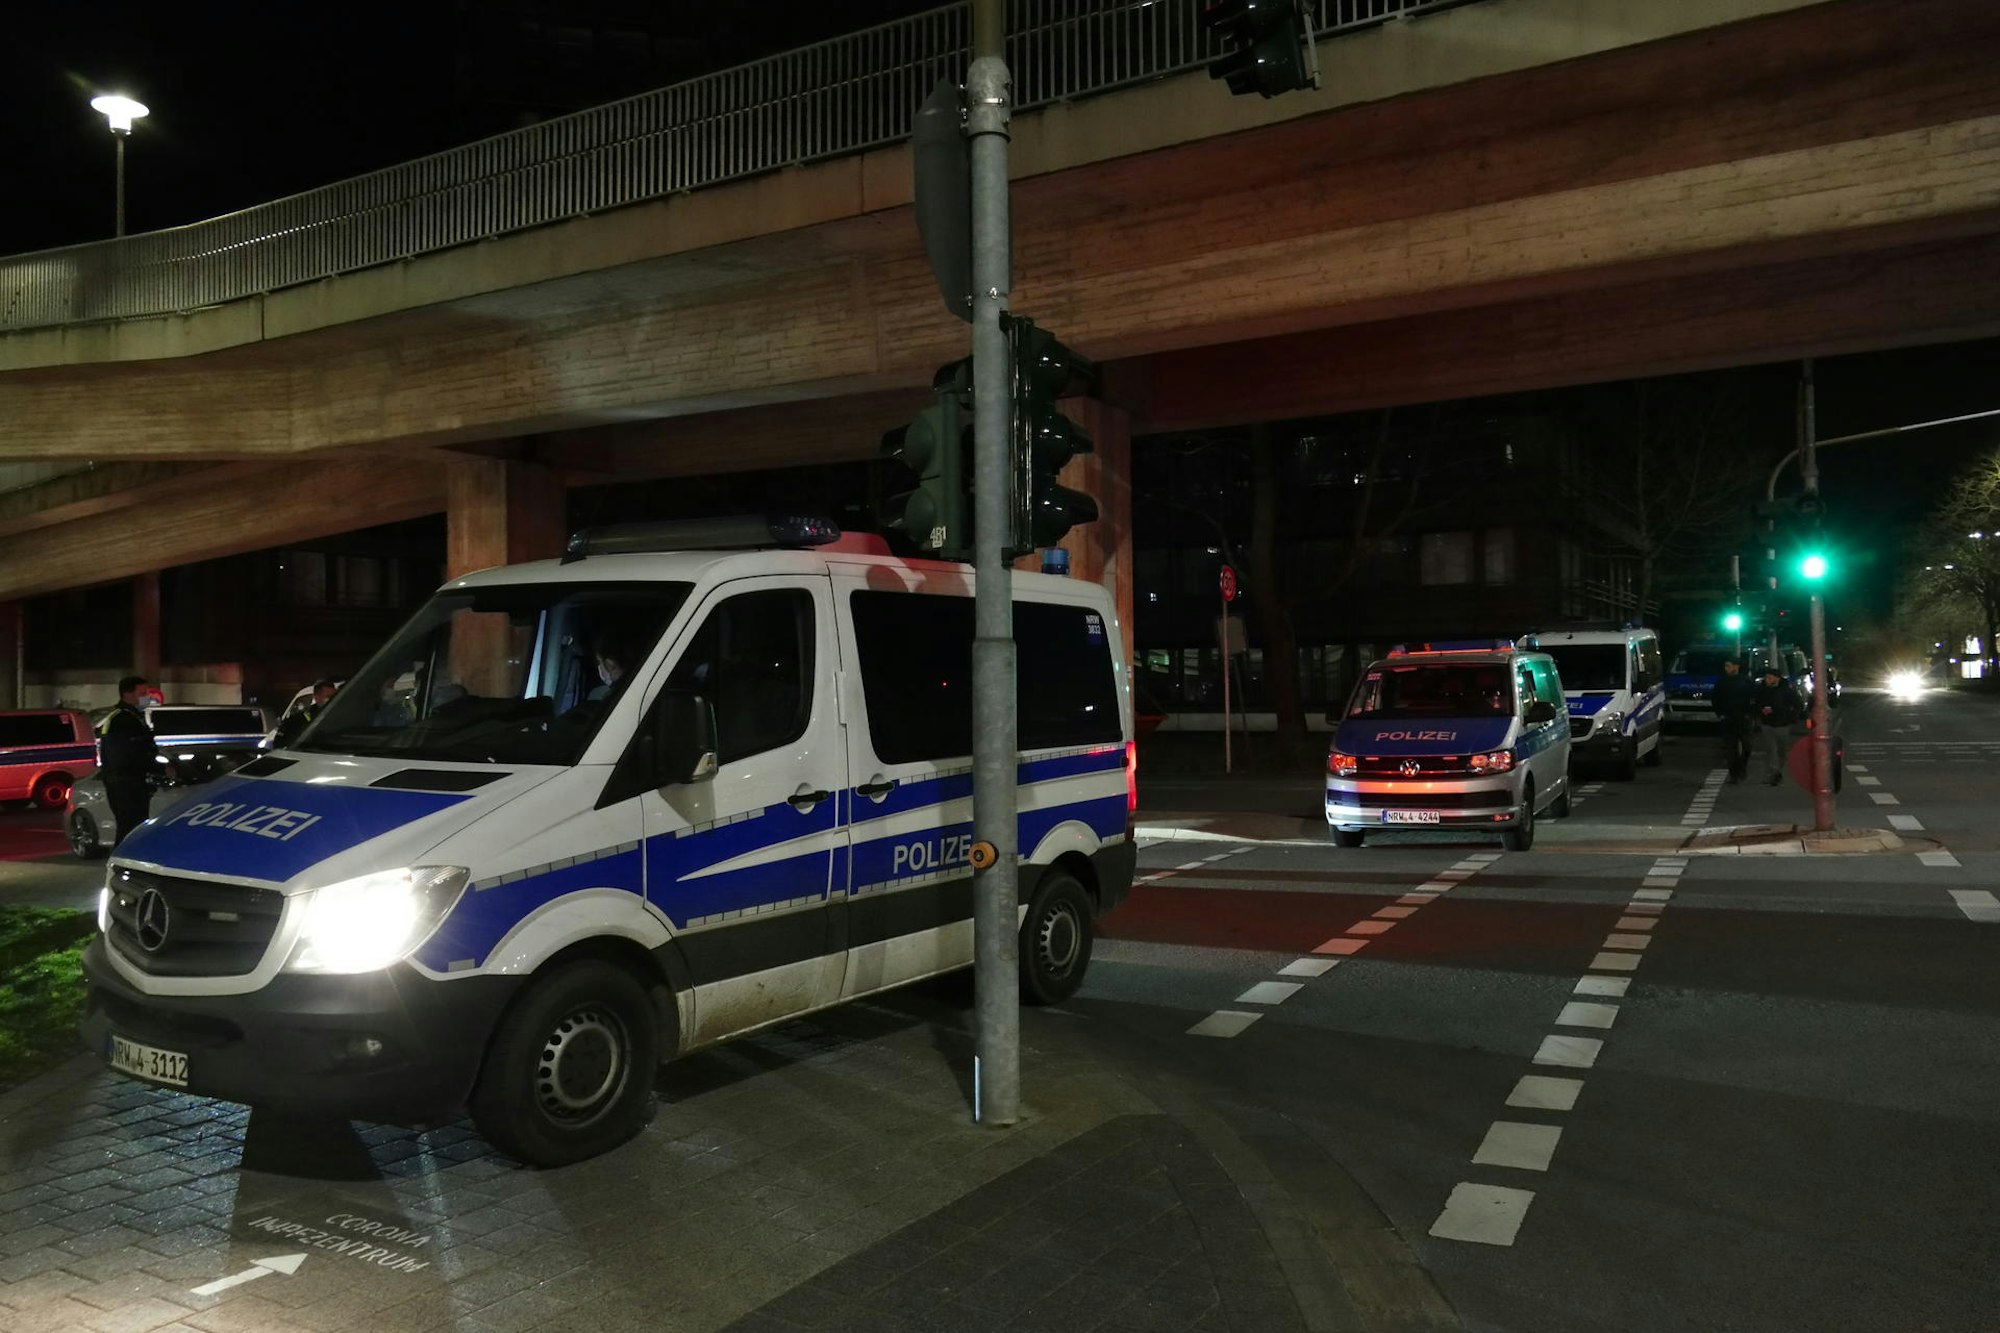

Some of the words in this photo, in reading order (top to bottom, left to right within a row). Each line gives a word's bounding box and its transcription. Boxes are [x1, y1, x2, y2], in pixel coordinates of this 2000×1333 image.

[1375, 731, 1457, 742] POLIZEI
[164, 803, 323, 842] POLIZEI
[1388, 812, 1404, 822] NRW
[893, 834, 972, 875] POLIZE
[247, 1216, 430, 1273] IMPFZENTRUM
[325, 1213, 431, 1249] CORONA
